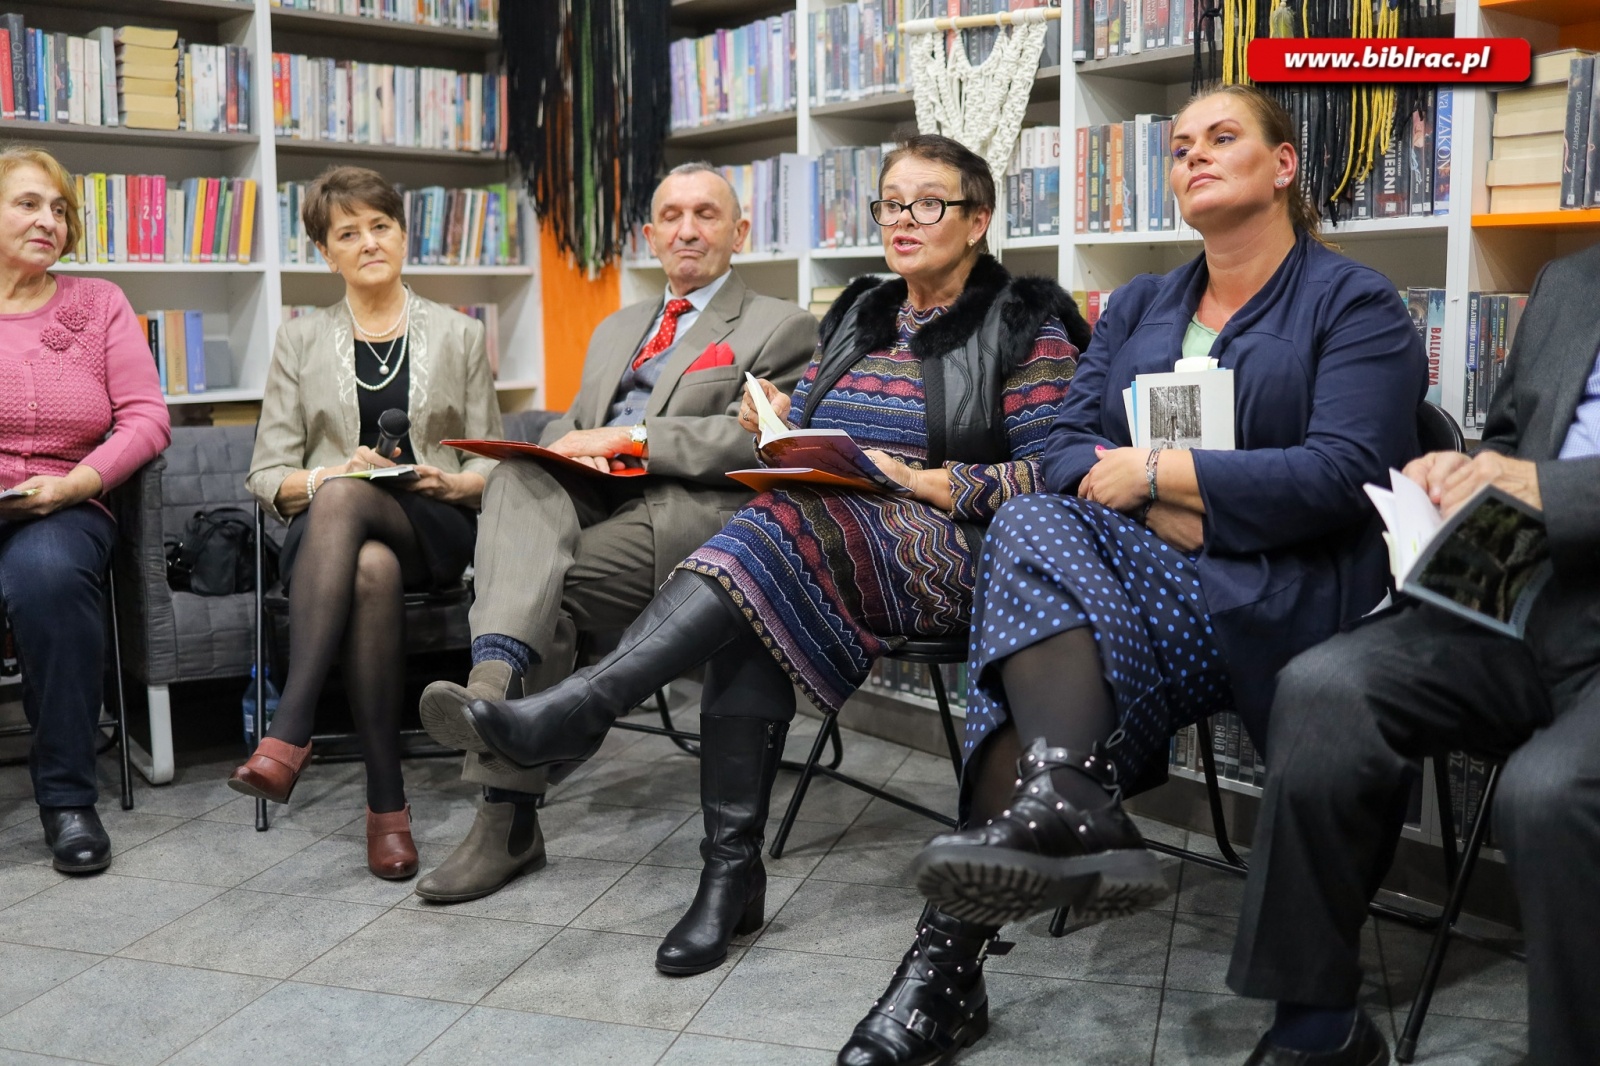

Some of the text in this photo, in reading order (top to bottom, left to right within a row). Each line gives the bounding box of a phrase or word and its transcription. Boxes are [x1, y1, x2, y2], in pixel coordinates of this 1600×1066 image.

[12, 42, 24, 81] OATES
[1436, 114, 1452, 170] ZAKON
[143, 205, 150, 220] 2
[155, 204, 162, 220] 3
[1428, 327, 1442, 387] BALLADYNA
[1468, 343, 1476, 366] KOBIETY
[1214, 724, 1227, 751] GRÓB
